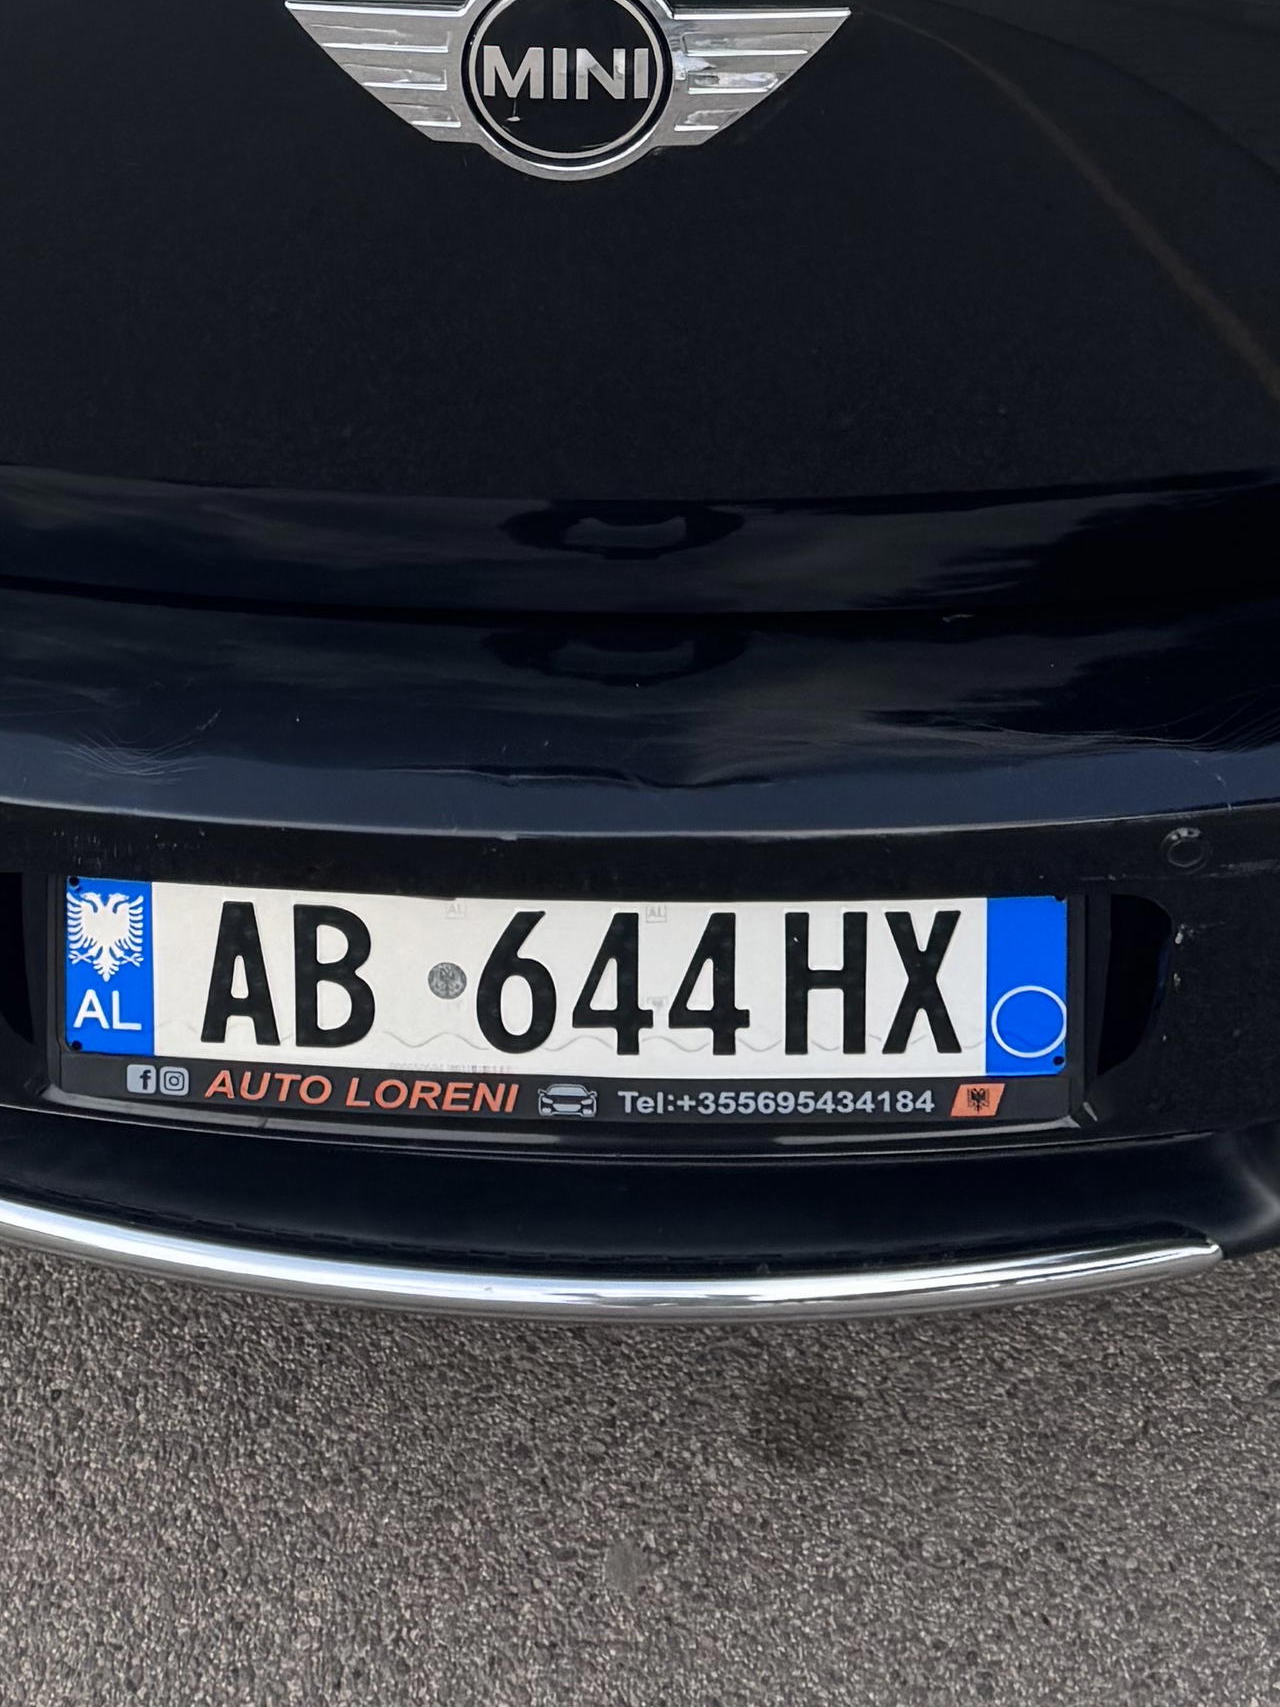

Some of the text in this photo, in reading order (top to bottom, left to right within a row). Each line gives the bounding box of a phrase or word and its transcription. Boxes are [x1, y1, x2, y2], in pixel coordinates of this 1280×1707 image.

[483, 44, 650, 100] MINI
[200, 900, 376, 1049] AB
[72, 988, 142, 1031] AL
[204, 1069, 332, 1106] AUTO
[345, 1076, 520, 1114] LORENI
